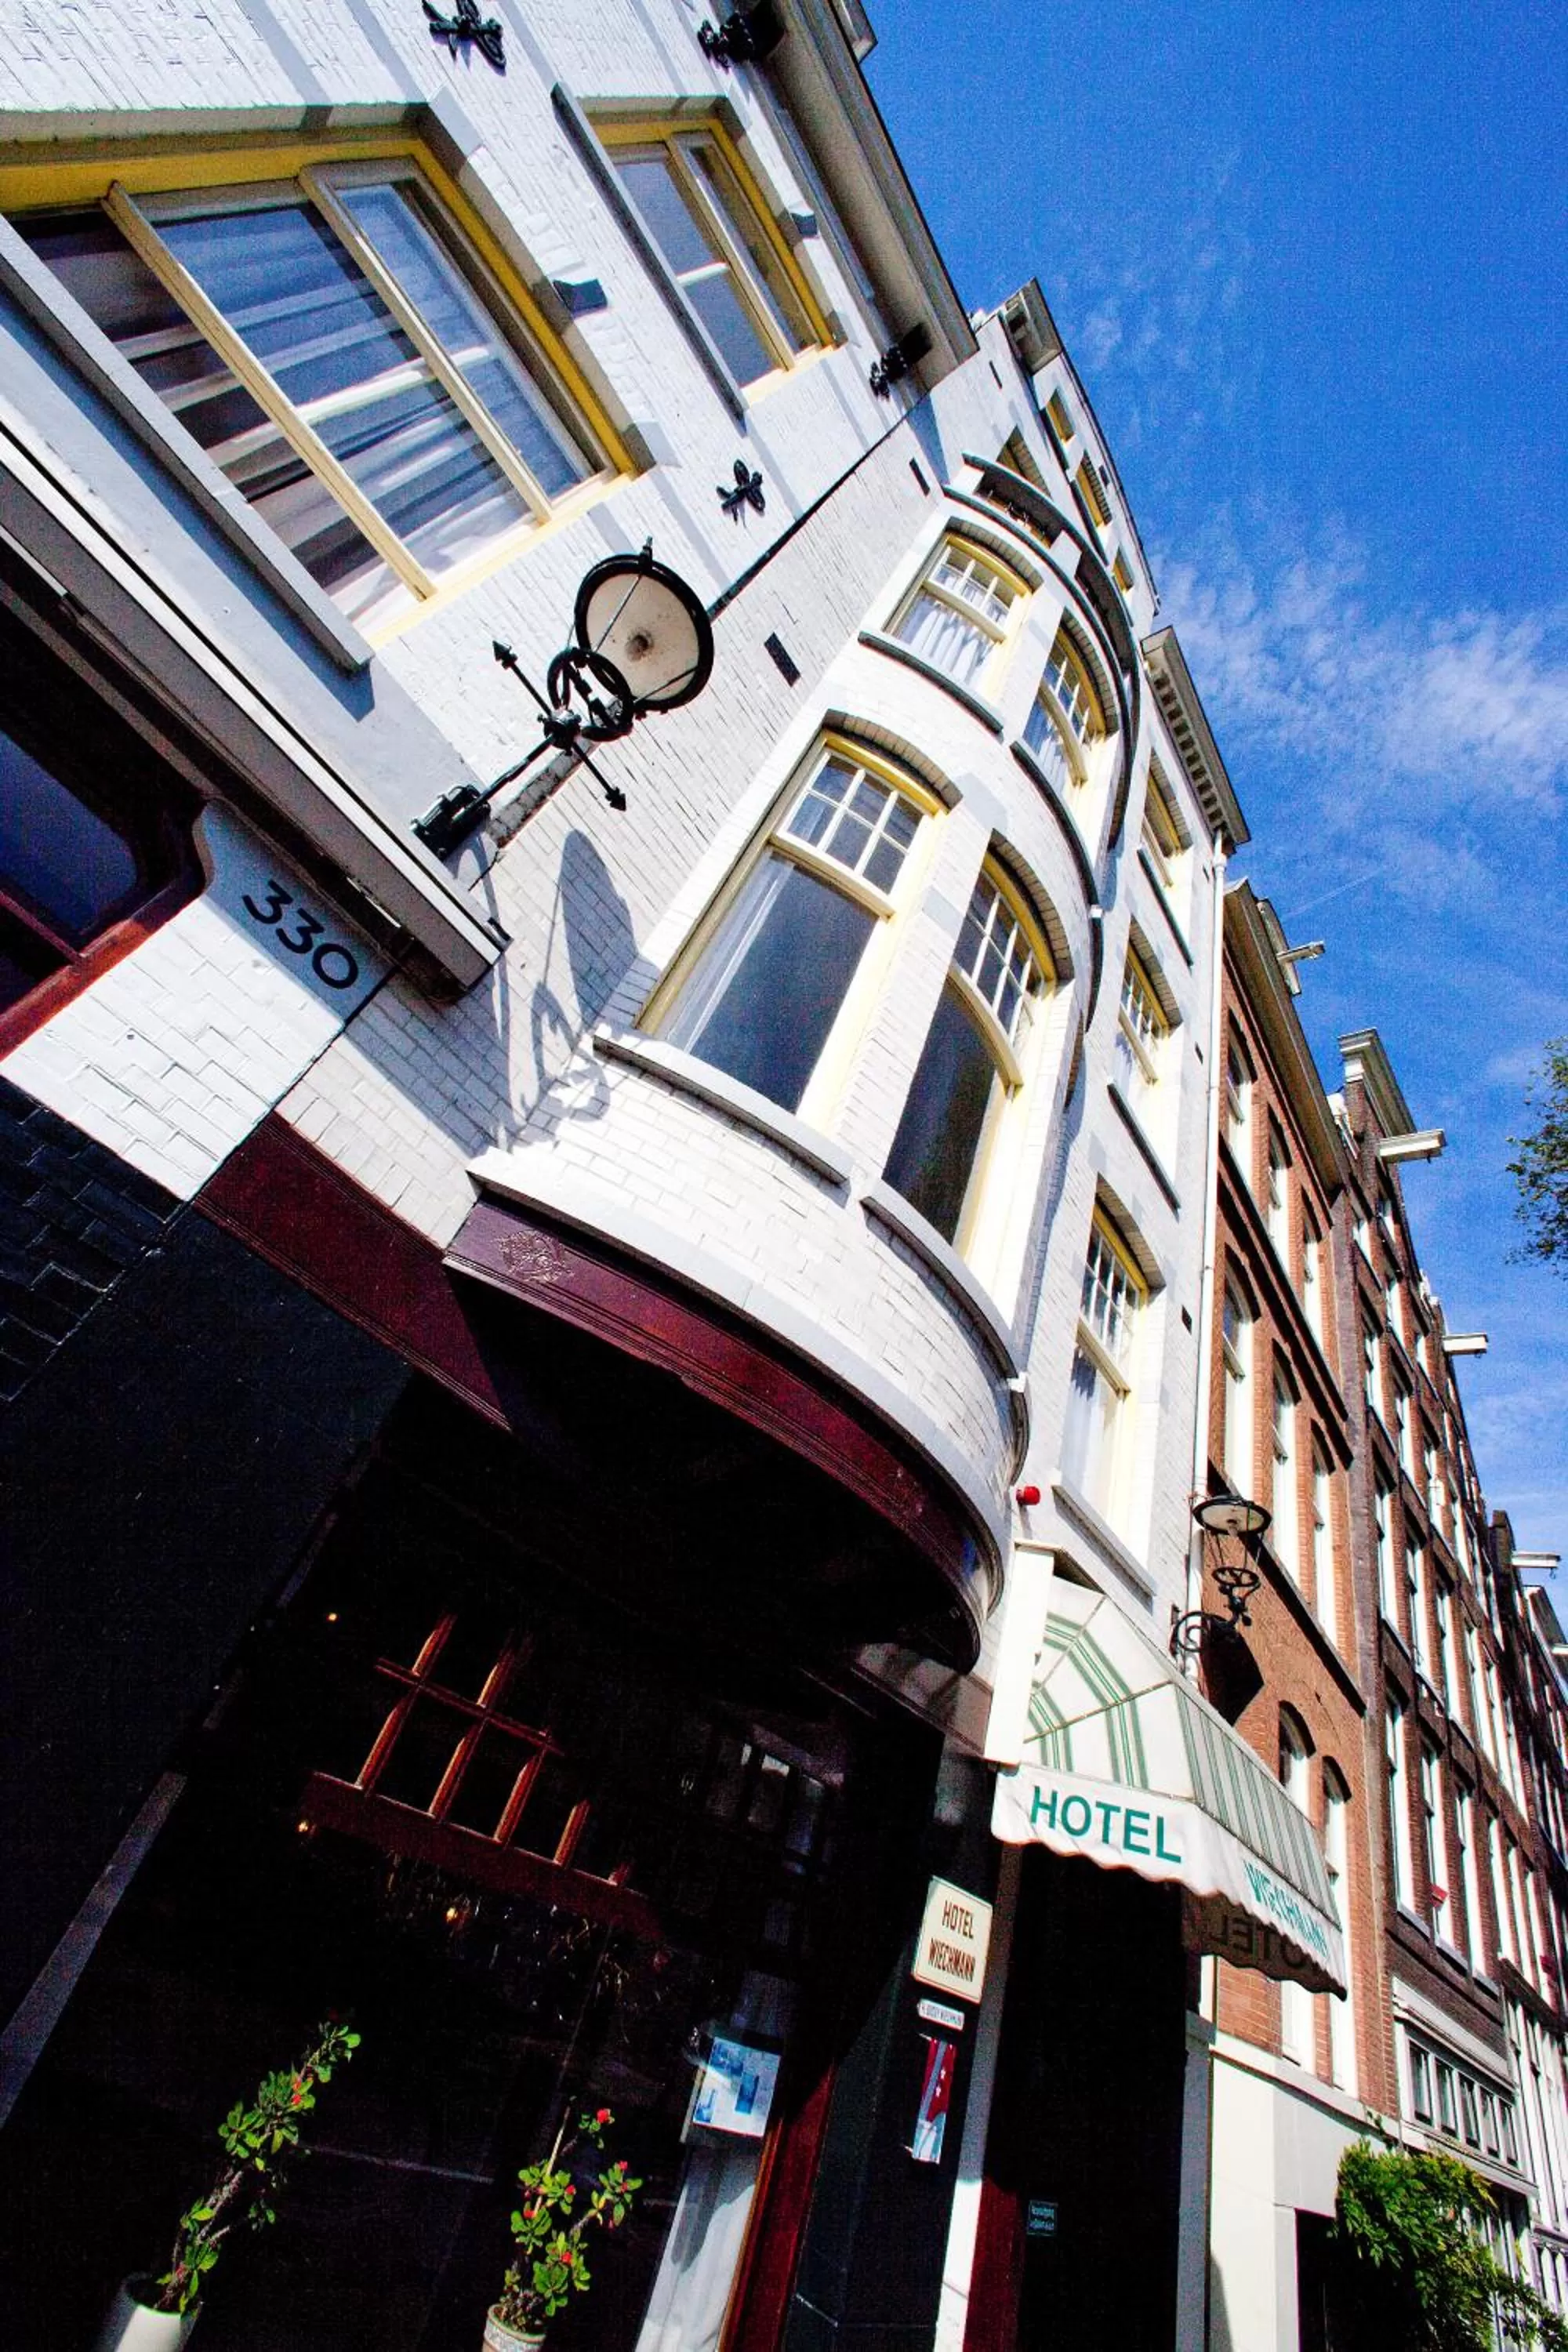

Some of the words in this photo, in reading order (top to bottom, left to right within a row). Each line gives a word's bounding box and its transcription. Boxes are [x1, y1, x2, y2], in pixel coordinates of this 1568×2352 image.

[241, 879, 358, 989] 330
[1029, 1785, 1181, 1864] HOTEL
[942, 1900, 974, 1939] HOTEL
[928, 1937, 976, 1982] WIECHMANN
